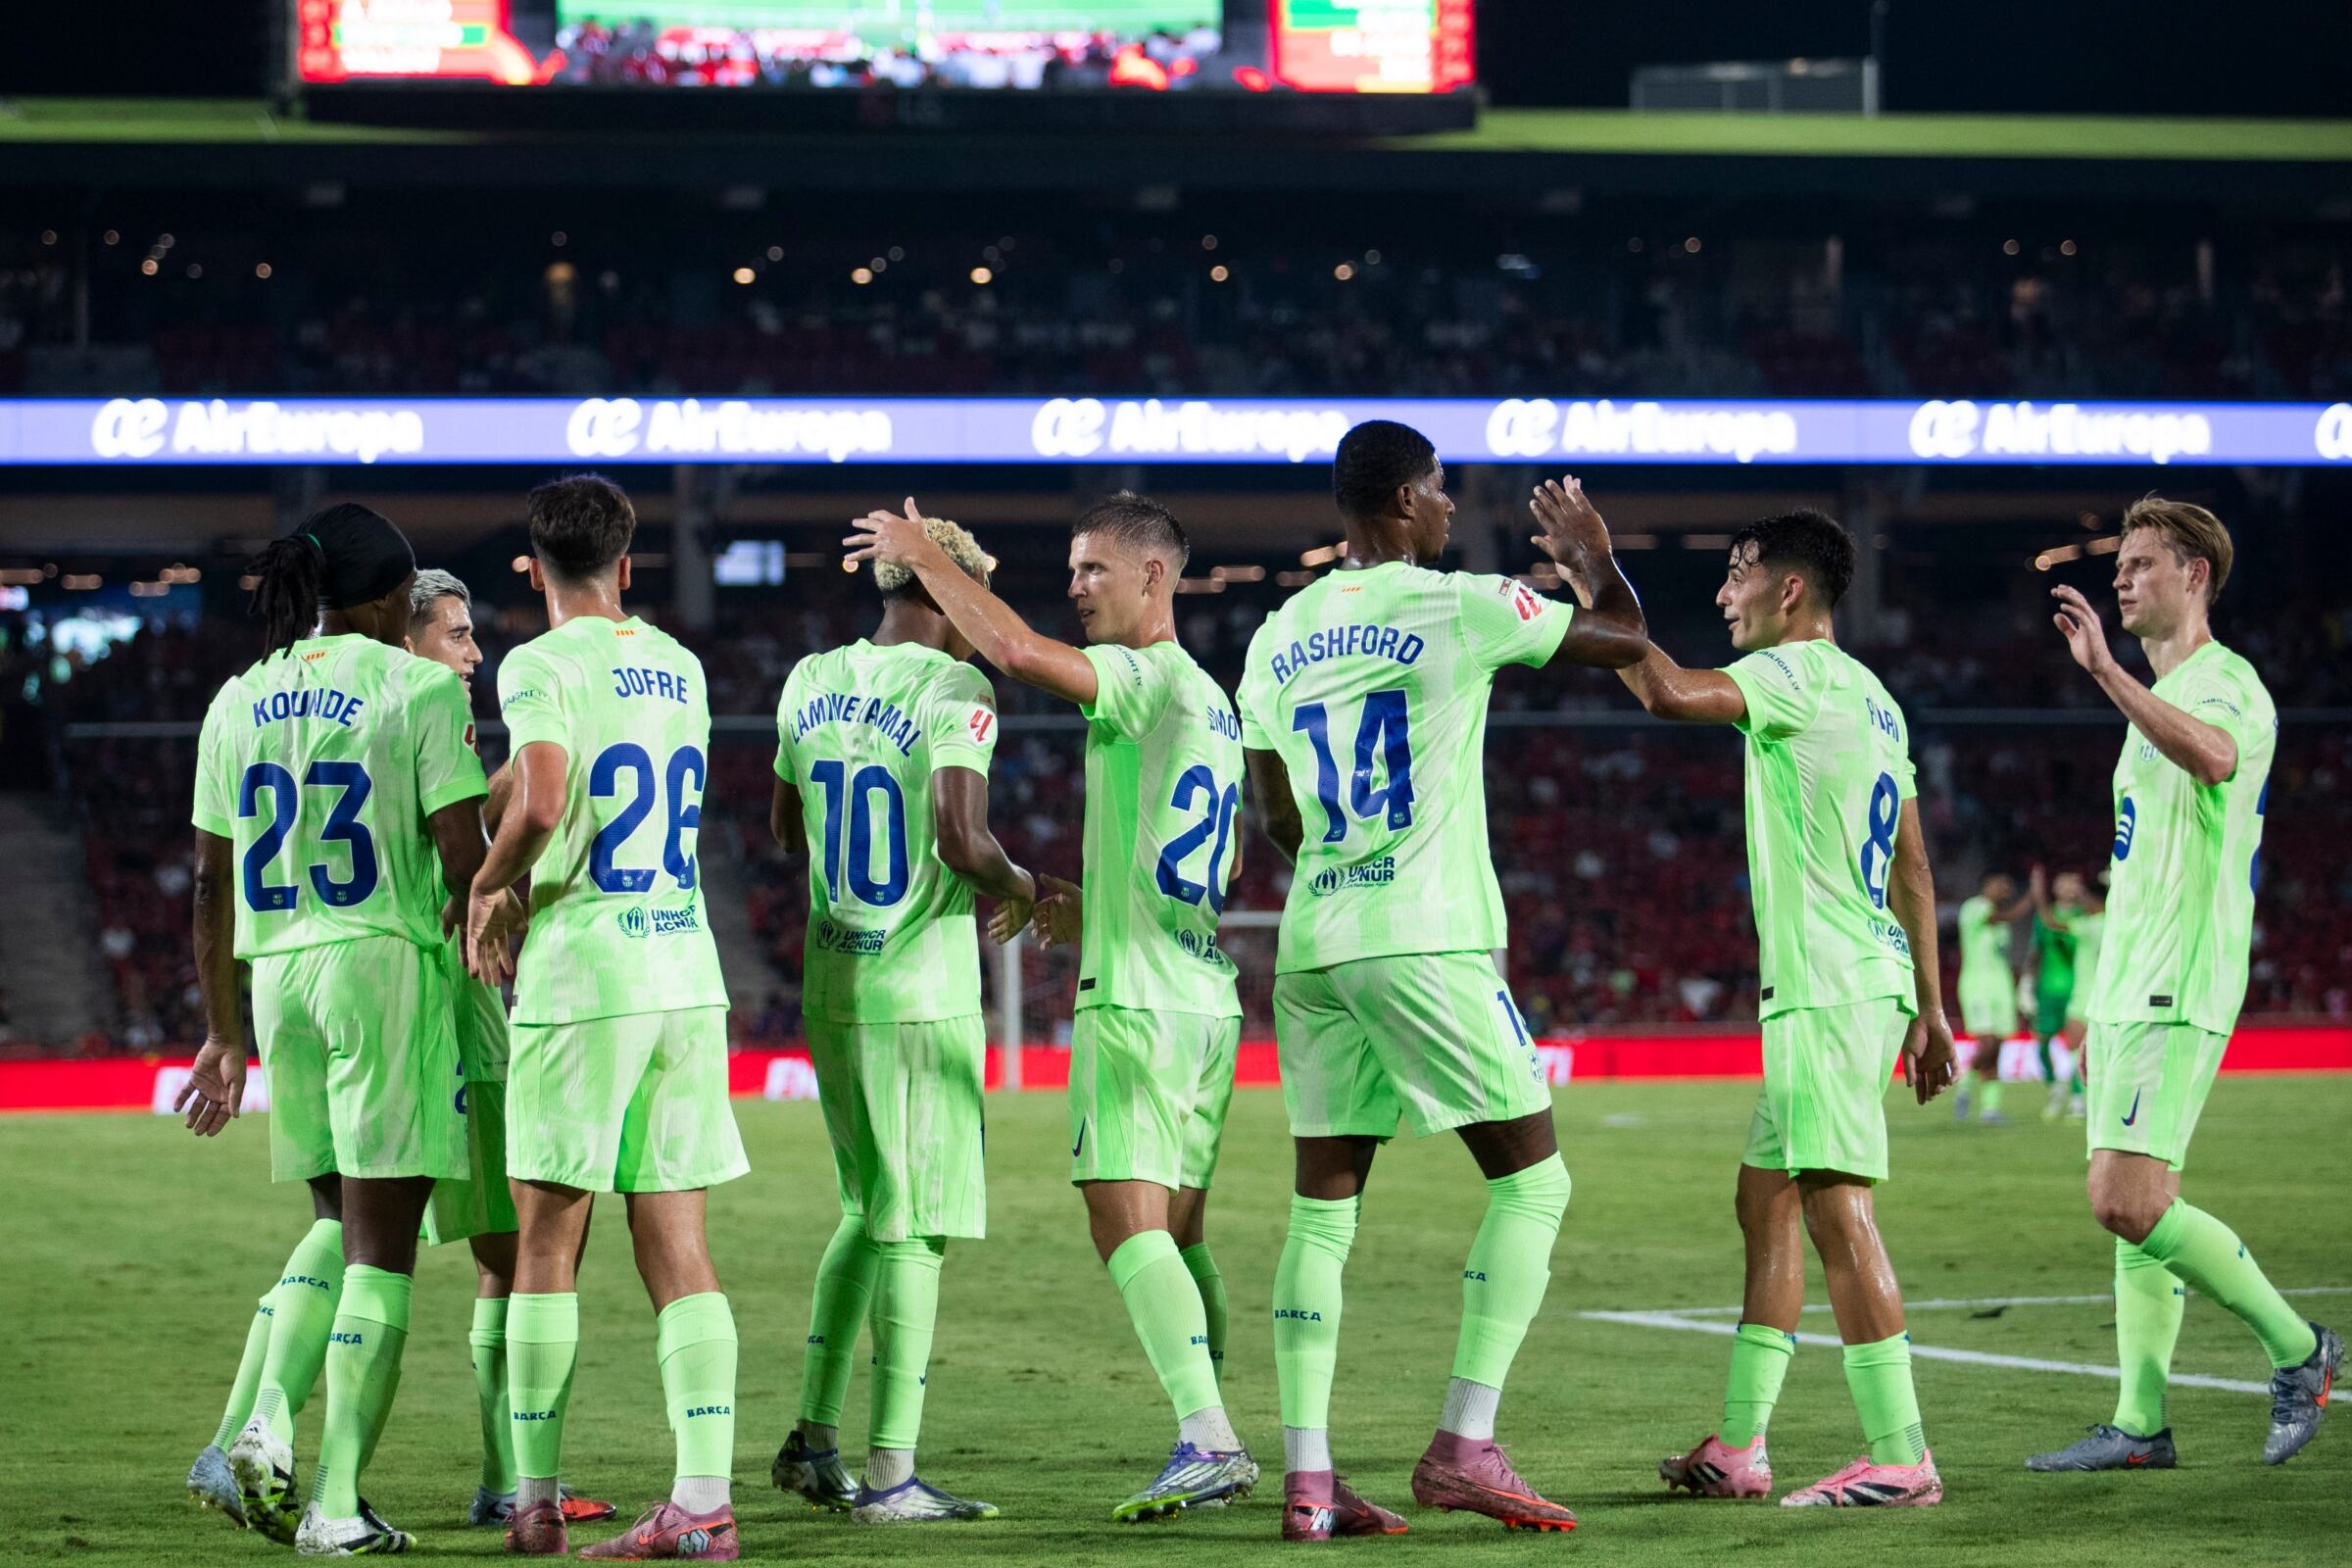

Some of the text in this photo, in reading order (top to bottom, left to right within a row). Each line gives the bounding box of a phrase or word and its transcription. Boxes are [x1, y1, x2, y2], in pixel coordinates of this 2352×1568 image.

[1270, 624, 1425, 685] RASHFORD
[252, 687, 365, 728] KOUNDE
[612, 666, 688, 705] JOFRE
[1292, 688, 1415, 843] 14
[238, 760, 379, 912] 23
[589, 742, 706, 894] 26
[809, 759, 909, 907] 10
[1860, 769, 1900, 910] 8
[837, 939, 884, 951] ACNUR
[844, 929, 886, 940] UNHCR
[1496, 990, 1530, 1047] 1
